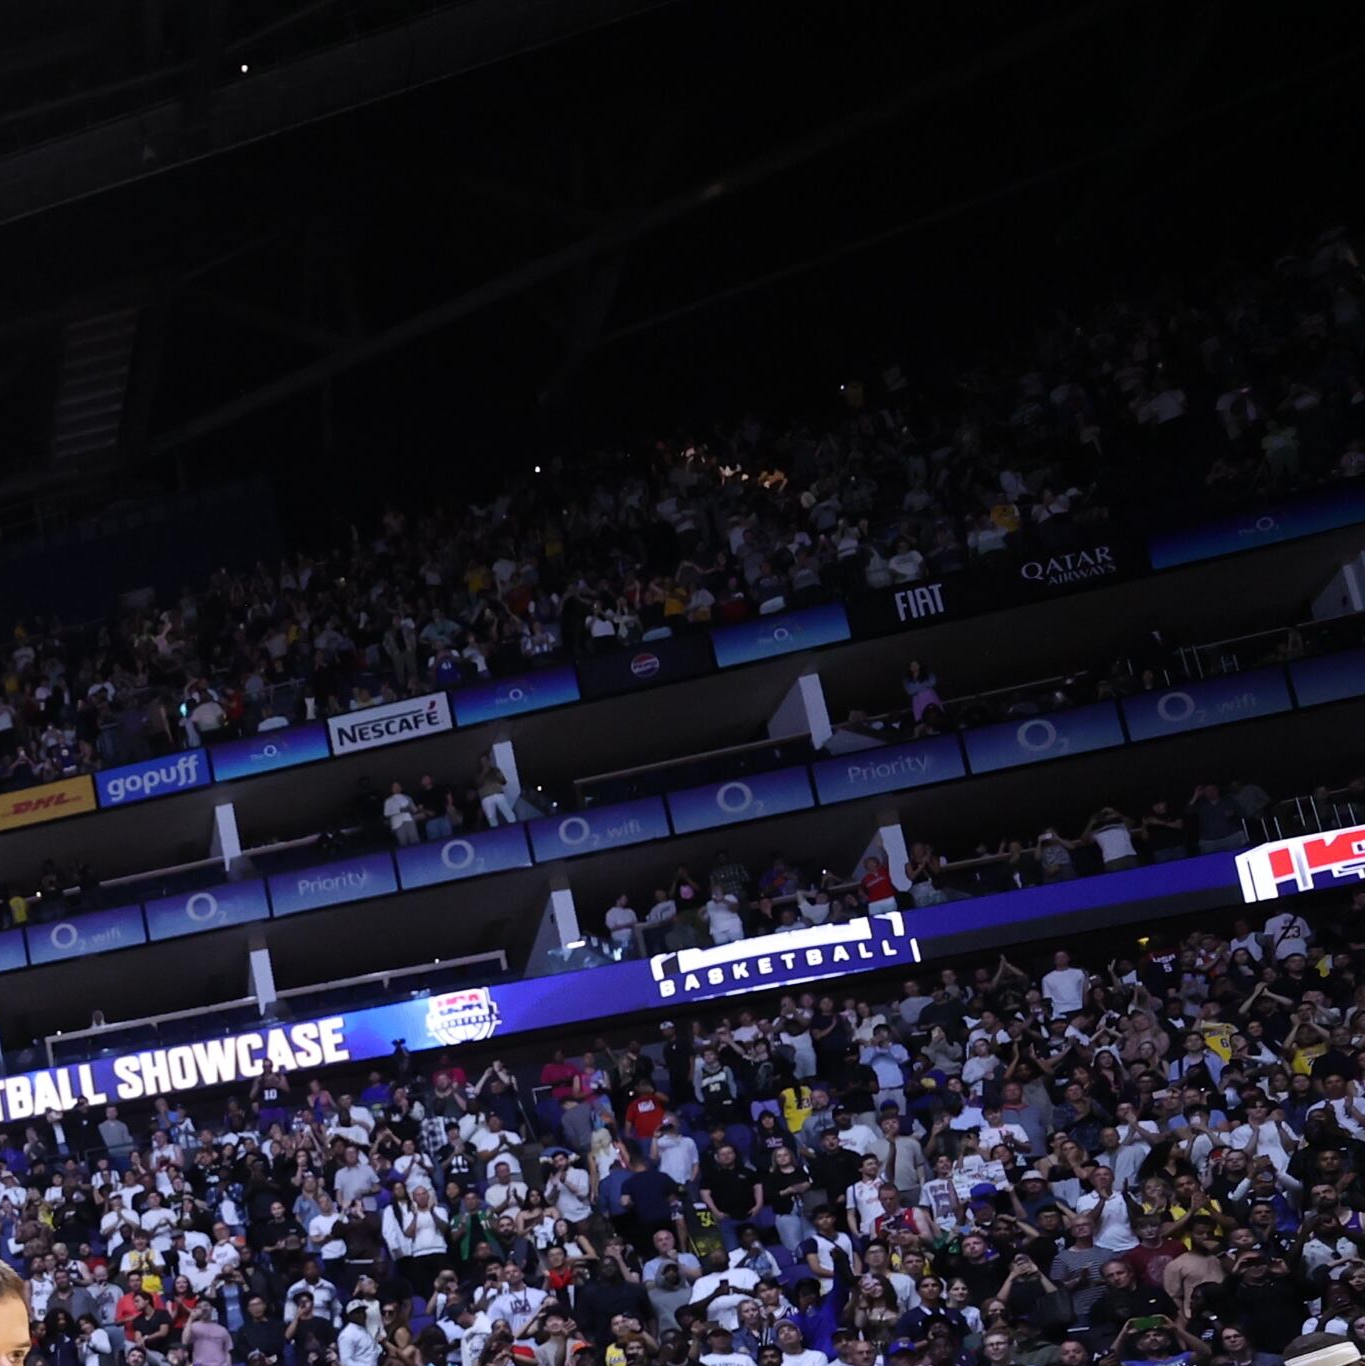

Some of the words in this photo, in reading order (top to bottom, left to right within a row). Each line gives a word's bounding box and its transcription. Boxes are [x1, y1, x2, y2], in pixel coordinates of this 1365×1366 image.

[1021, 545, 1113, 581] QATAR
[1048, 561, 1117, 586] AIRWAYS
[894, 582, 946, 622] FIAT
[106, 754, 199, 802] gopuff
[847, 752, 931, 785] Priority
[297, 868, 368, 896] Priority
[659, 939, 897, 998] BASKETBALL
[114, 1017, 351, 1103] SHOWCASE
